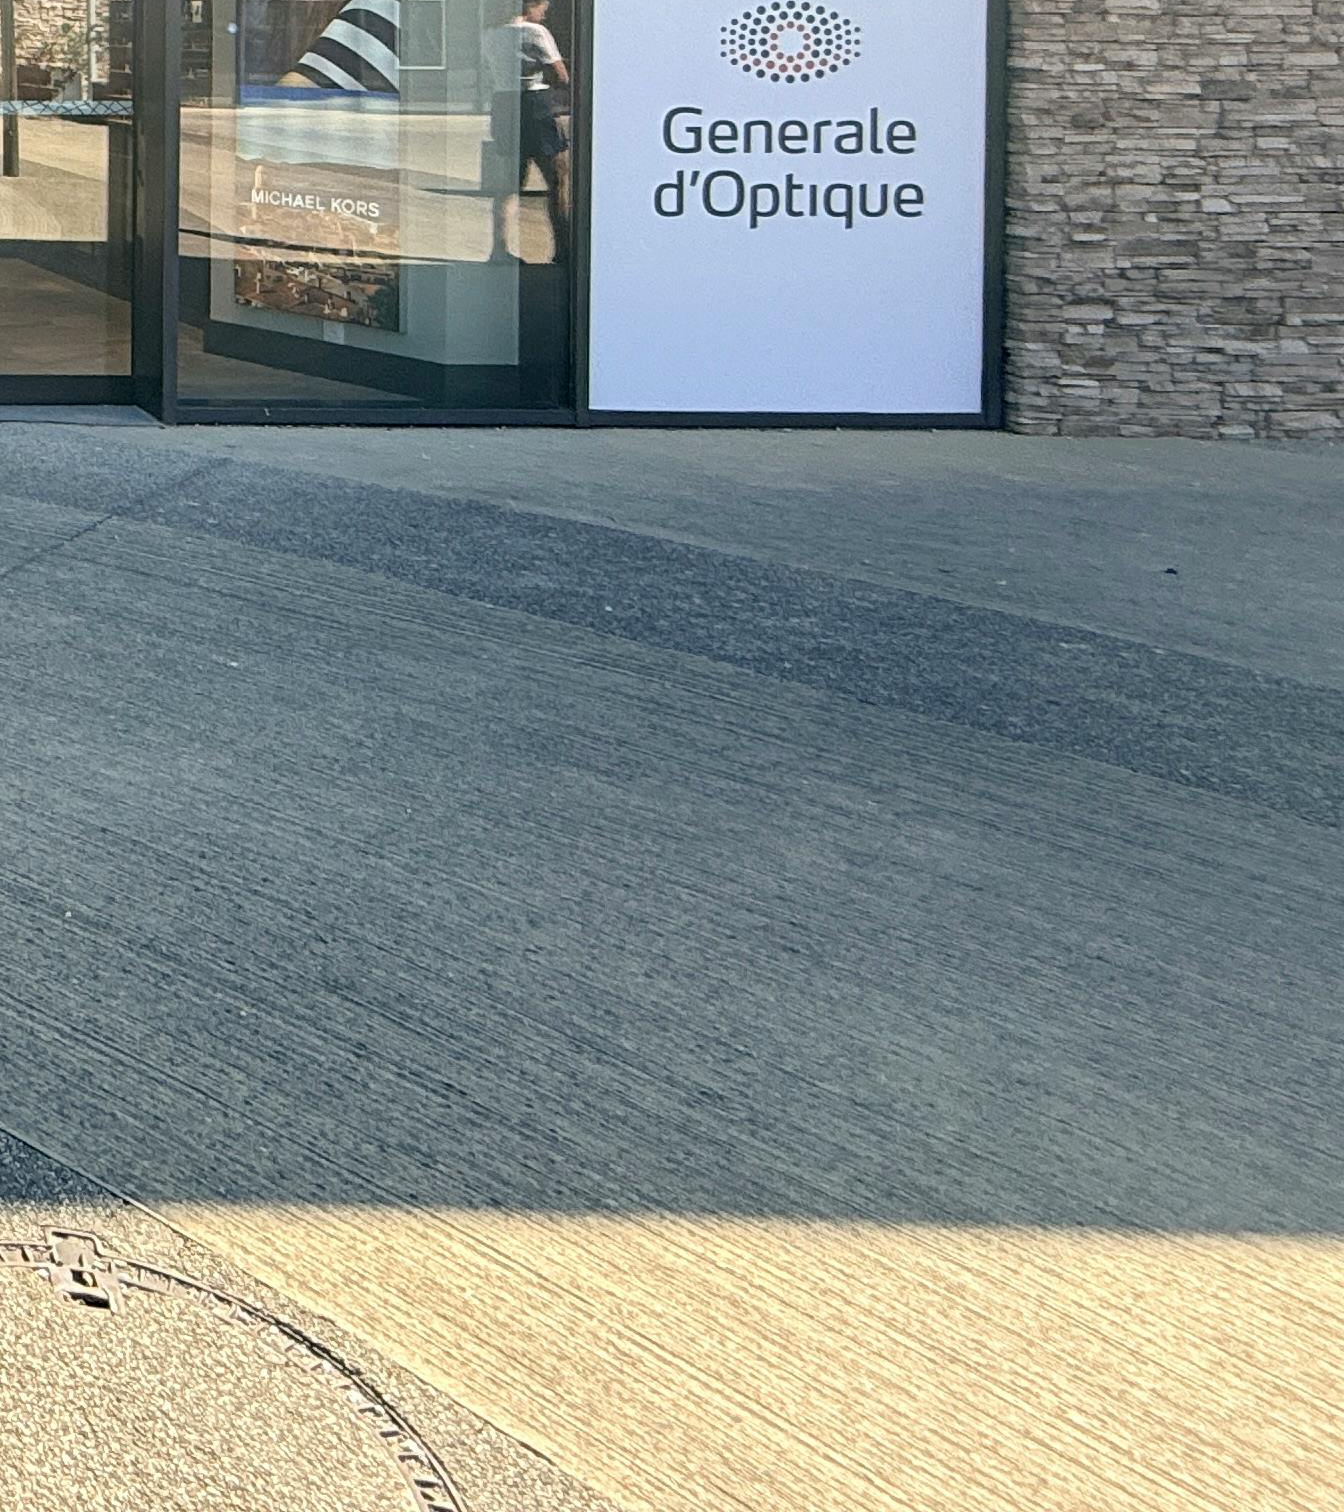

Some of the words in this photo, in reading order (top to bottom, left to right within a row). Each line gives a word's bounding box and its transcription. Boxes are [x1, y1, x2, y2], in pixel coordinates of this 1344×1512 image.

[662, 106, 917, 155] Generale
[250, 189, 326, 211] MICHAEL
[330, 197, 381, 218] KORS
[654, 169, 925, 229] d'Optique
